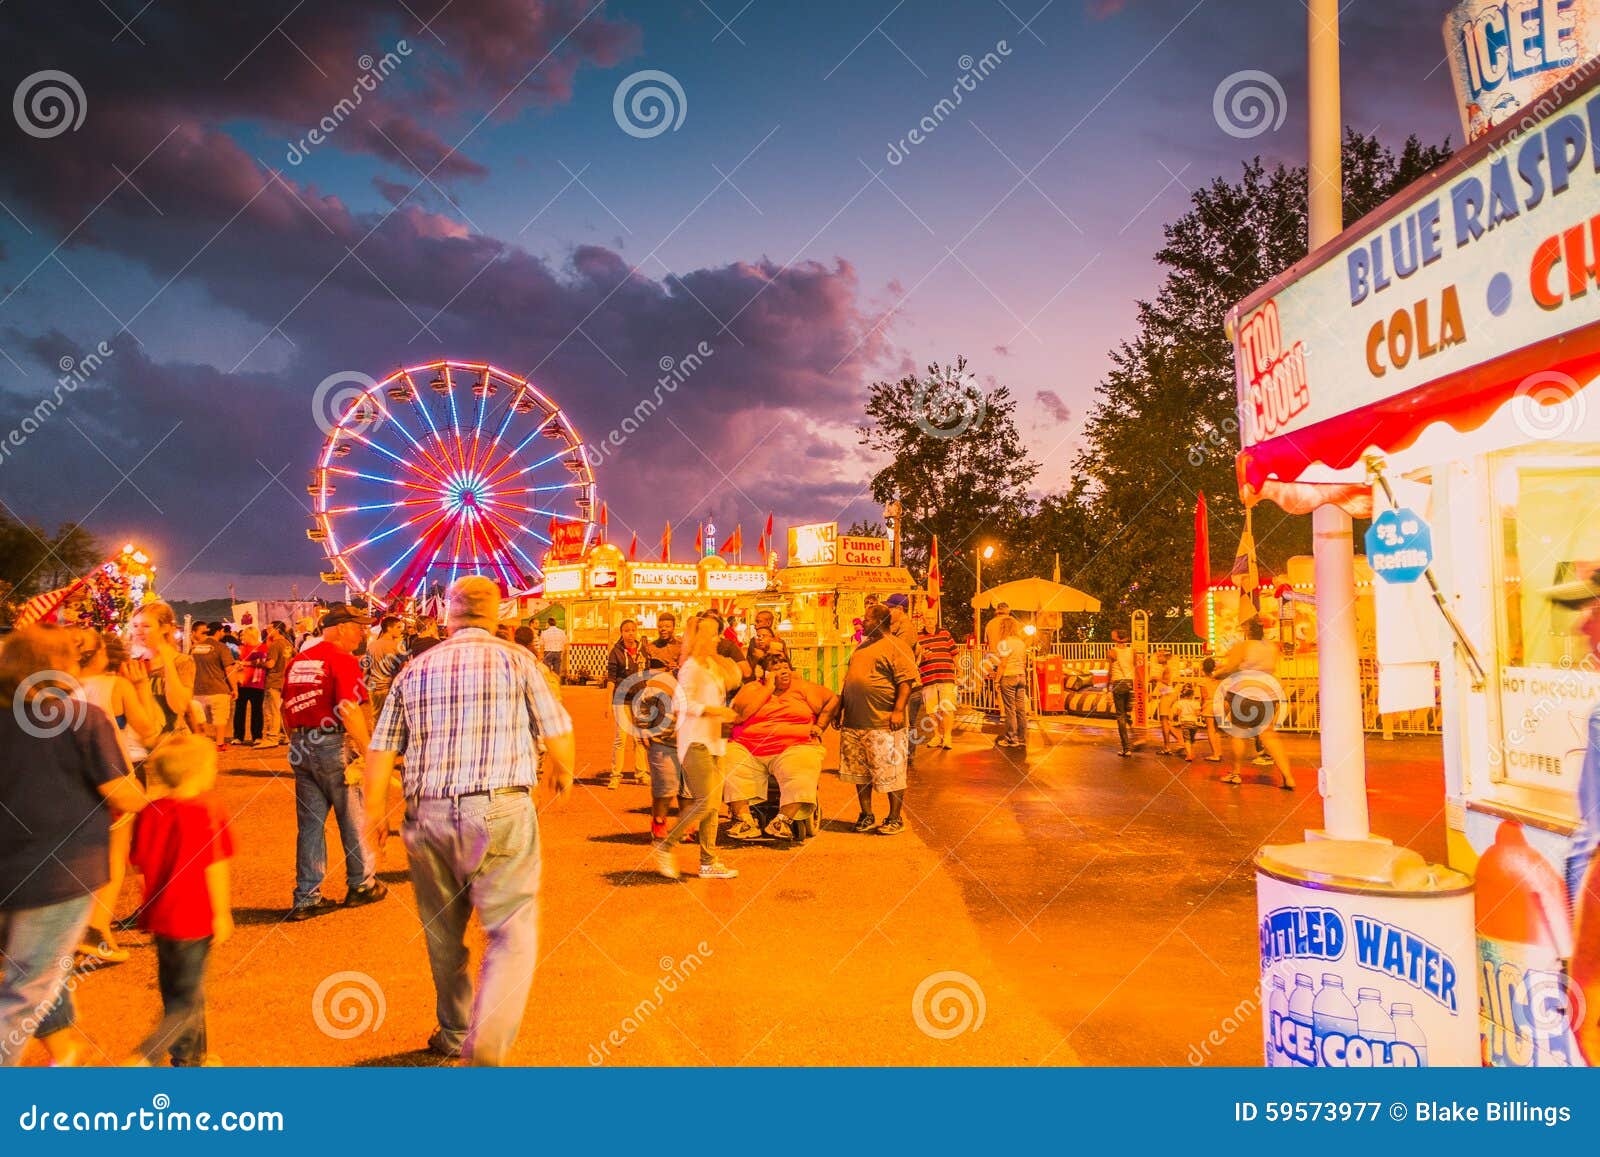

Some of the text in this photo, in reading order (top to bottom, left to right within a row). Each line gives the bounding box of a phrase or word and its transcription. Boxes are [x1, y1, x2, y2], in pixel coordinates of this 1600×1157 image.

[1463, 0, 1578, 99] ICEE
[1346, 198, 1442, 307] BLUE
[1240, 299, 1282, 385] TOO
[1366, 284, 1467, 378] COLA
[1249, 341, 1311, 443] COOL!
[633, 572, 697, 586] ITALIAN SAUSAGE
[842, 537, 885, 551] Funnel
[845, 552, 881, 564] Cakes
[1503, 678, 1600, 701] HOT CHOCOLA
[1509, 750, 1562, 776] COFFEE
[1261, 907, 1459, 1014] OTTLED WATER
[1271, 1010, 1420, 1067] ICE COLD
